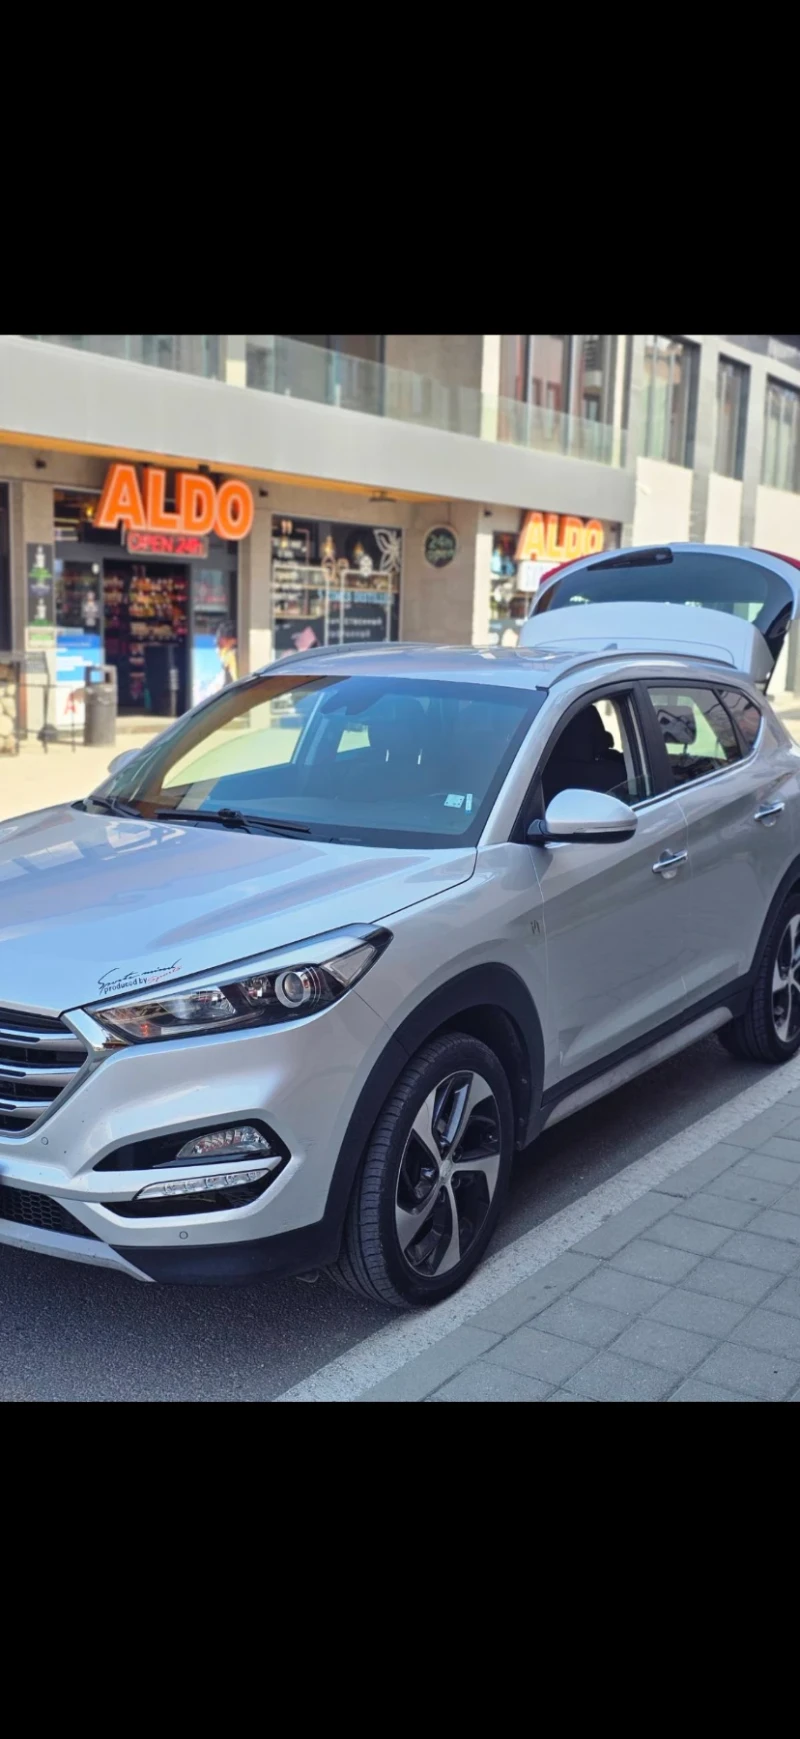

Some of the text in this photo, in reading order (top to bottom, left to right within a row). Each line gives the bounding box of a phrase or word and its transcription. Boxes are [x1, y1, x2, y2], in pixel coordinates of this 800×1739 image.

[93, 463, 254, 541] ALDO
[127, 532, 174, 553] OPEN
[514, 511, 604, 562] ALDO
[104, 978, 137, 995] produced
[138, 976, 148, 985] by
